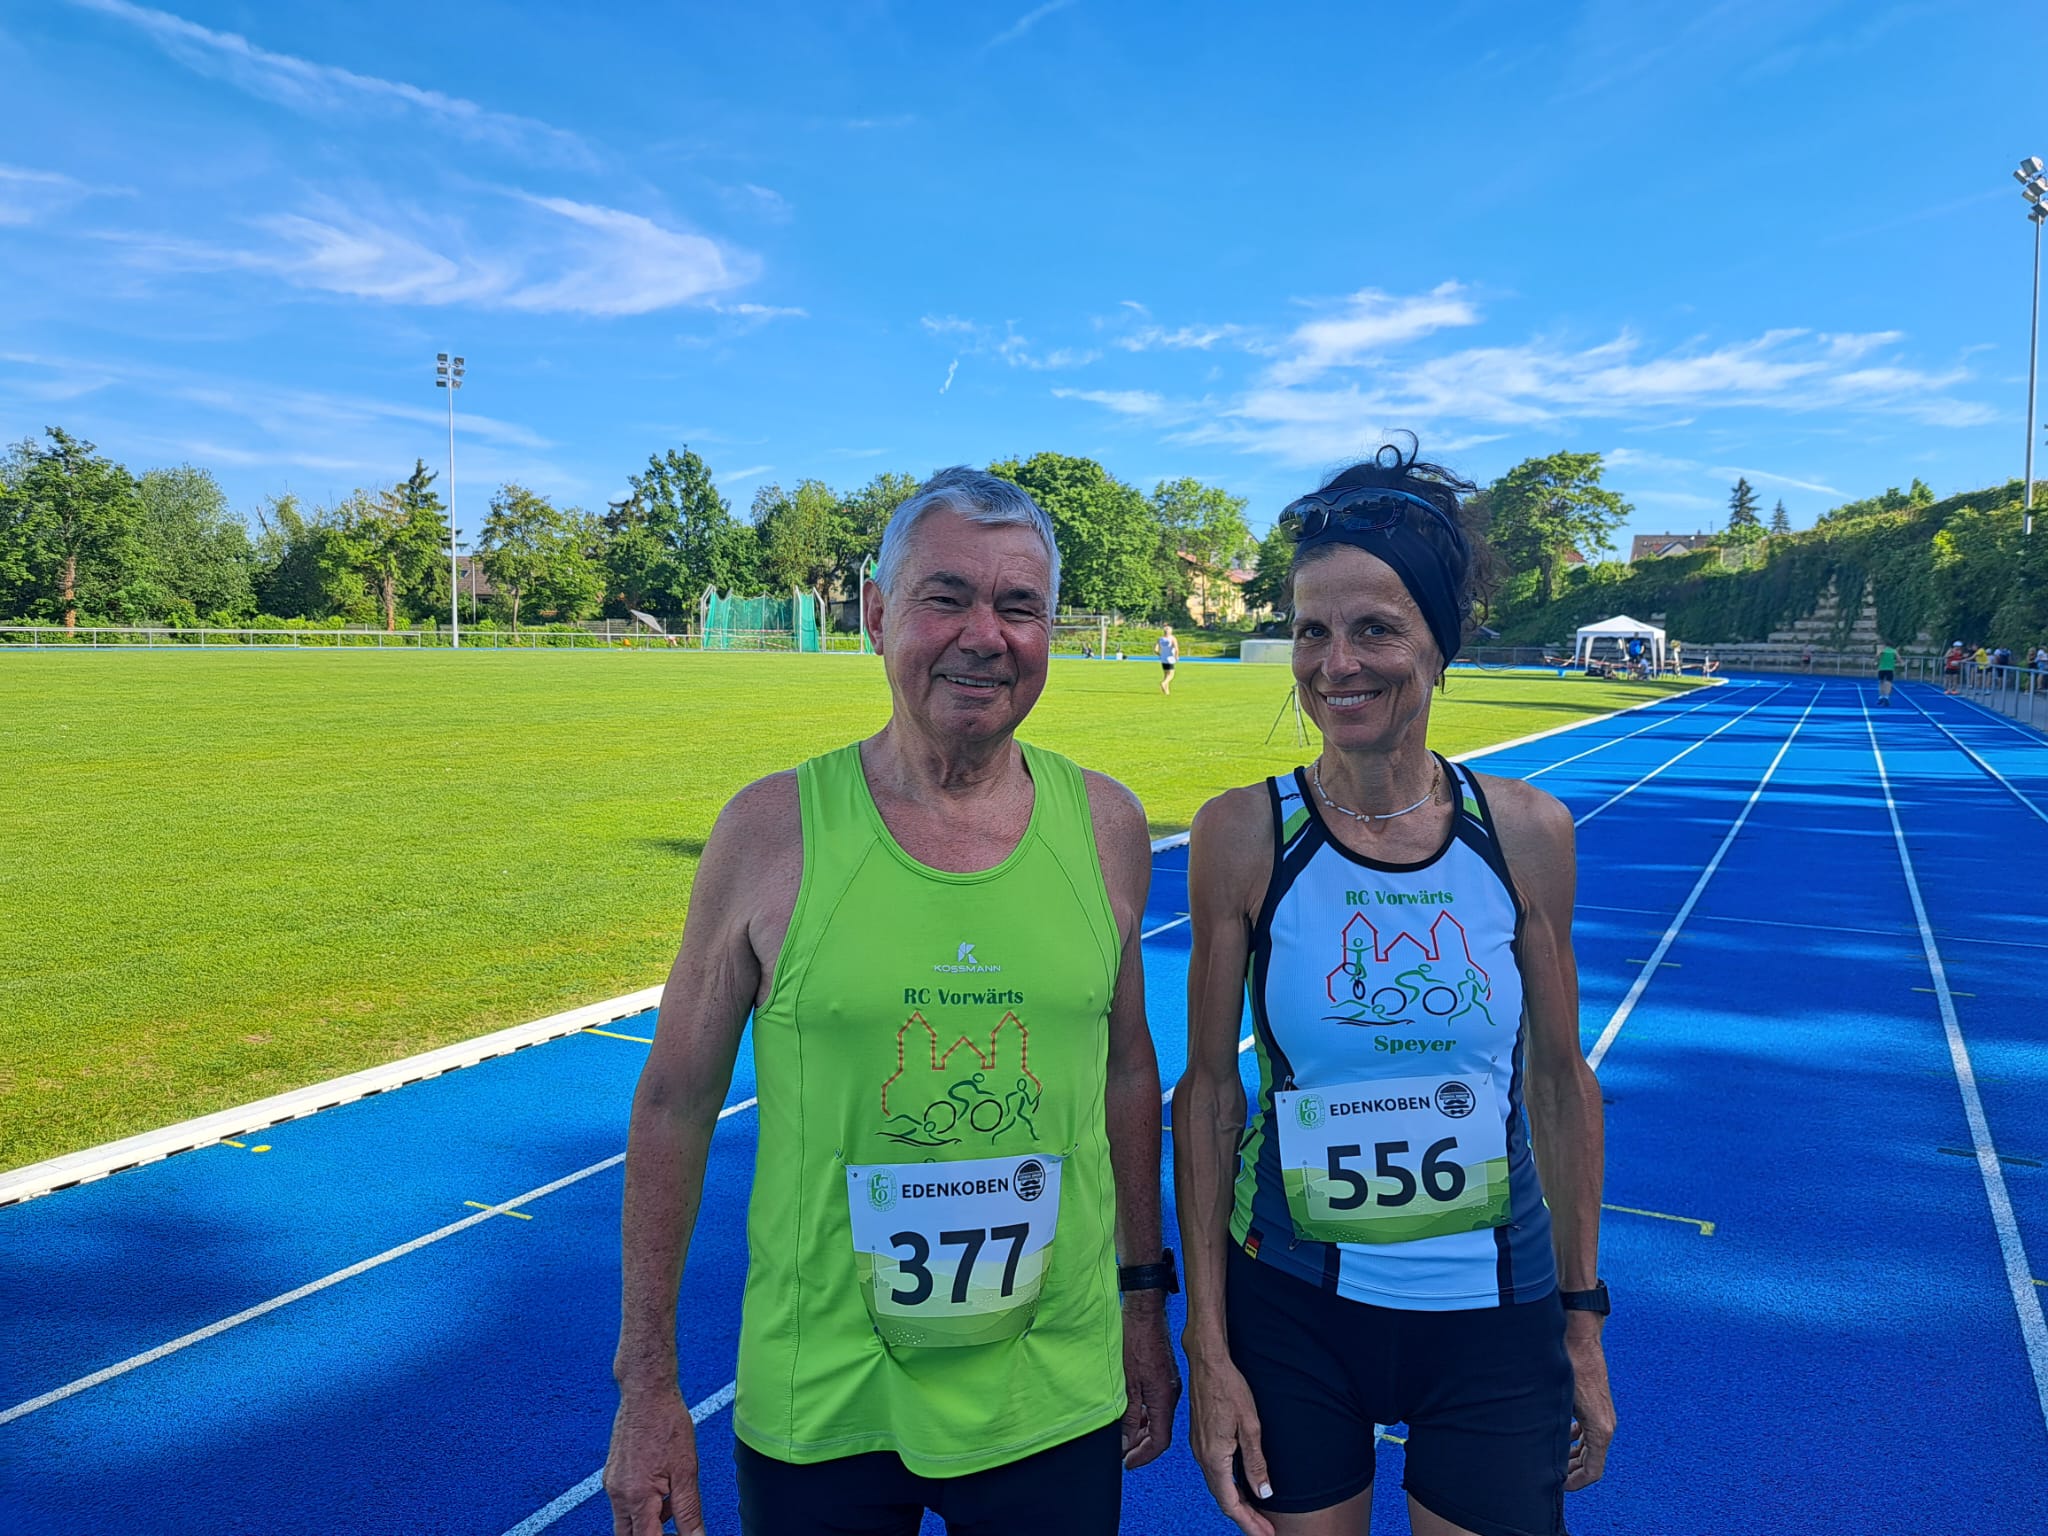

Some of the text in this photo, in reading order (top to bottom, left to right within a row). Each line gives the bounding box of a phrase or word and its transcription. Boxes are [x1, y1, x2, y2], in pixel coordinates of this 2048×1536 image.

[1346, 890, 1454, 905] RC Vorwärts
[934, 965, 1000, 973] KOSSMANN
[904, 988, 1024, 1005] RC Vorwärts
[1374, 1035, 1456, 1054] Speyer
[1330, 1097, 1430, 1116] EDENKOBEN
[1327, 1136, 1466, 1210] 556
[902, 1178, 1009, 1199] EDENKOBEN
[890, 1222, 1030, 1306] 377
